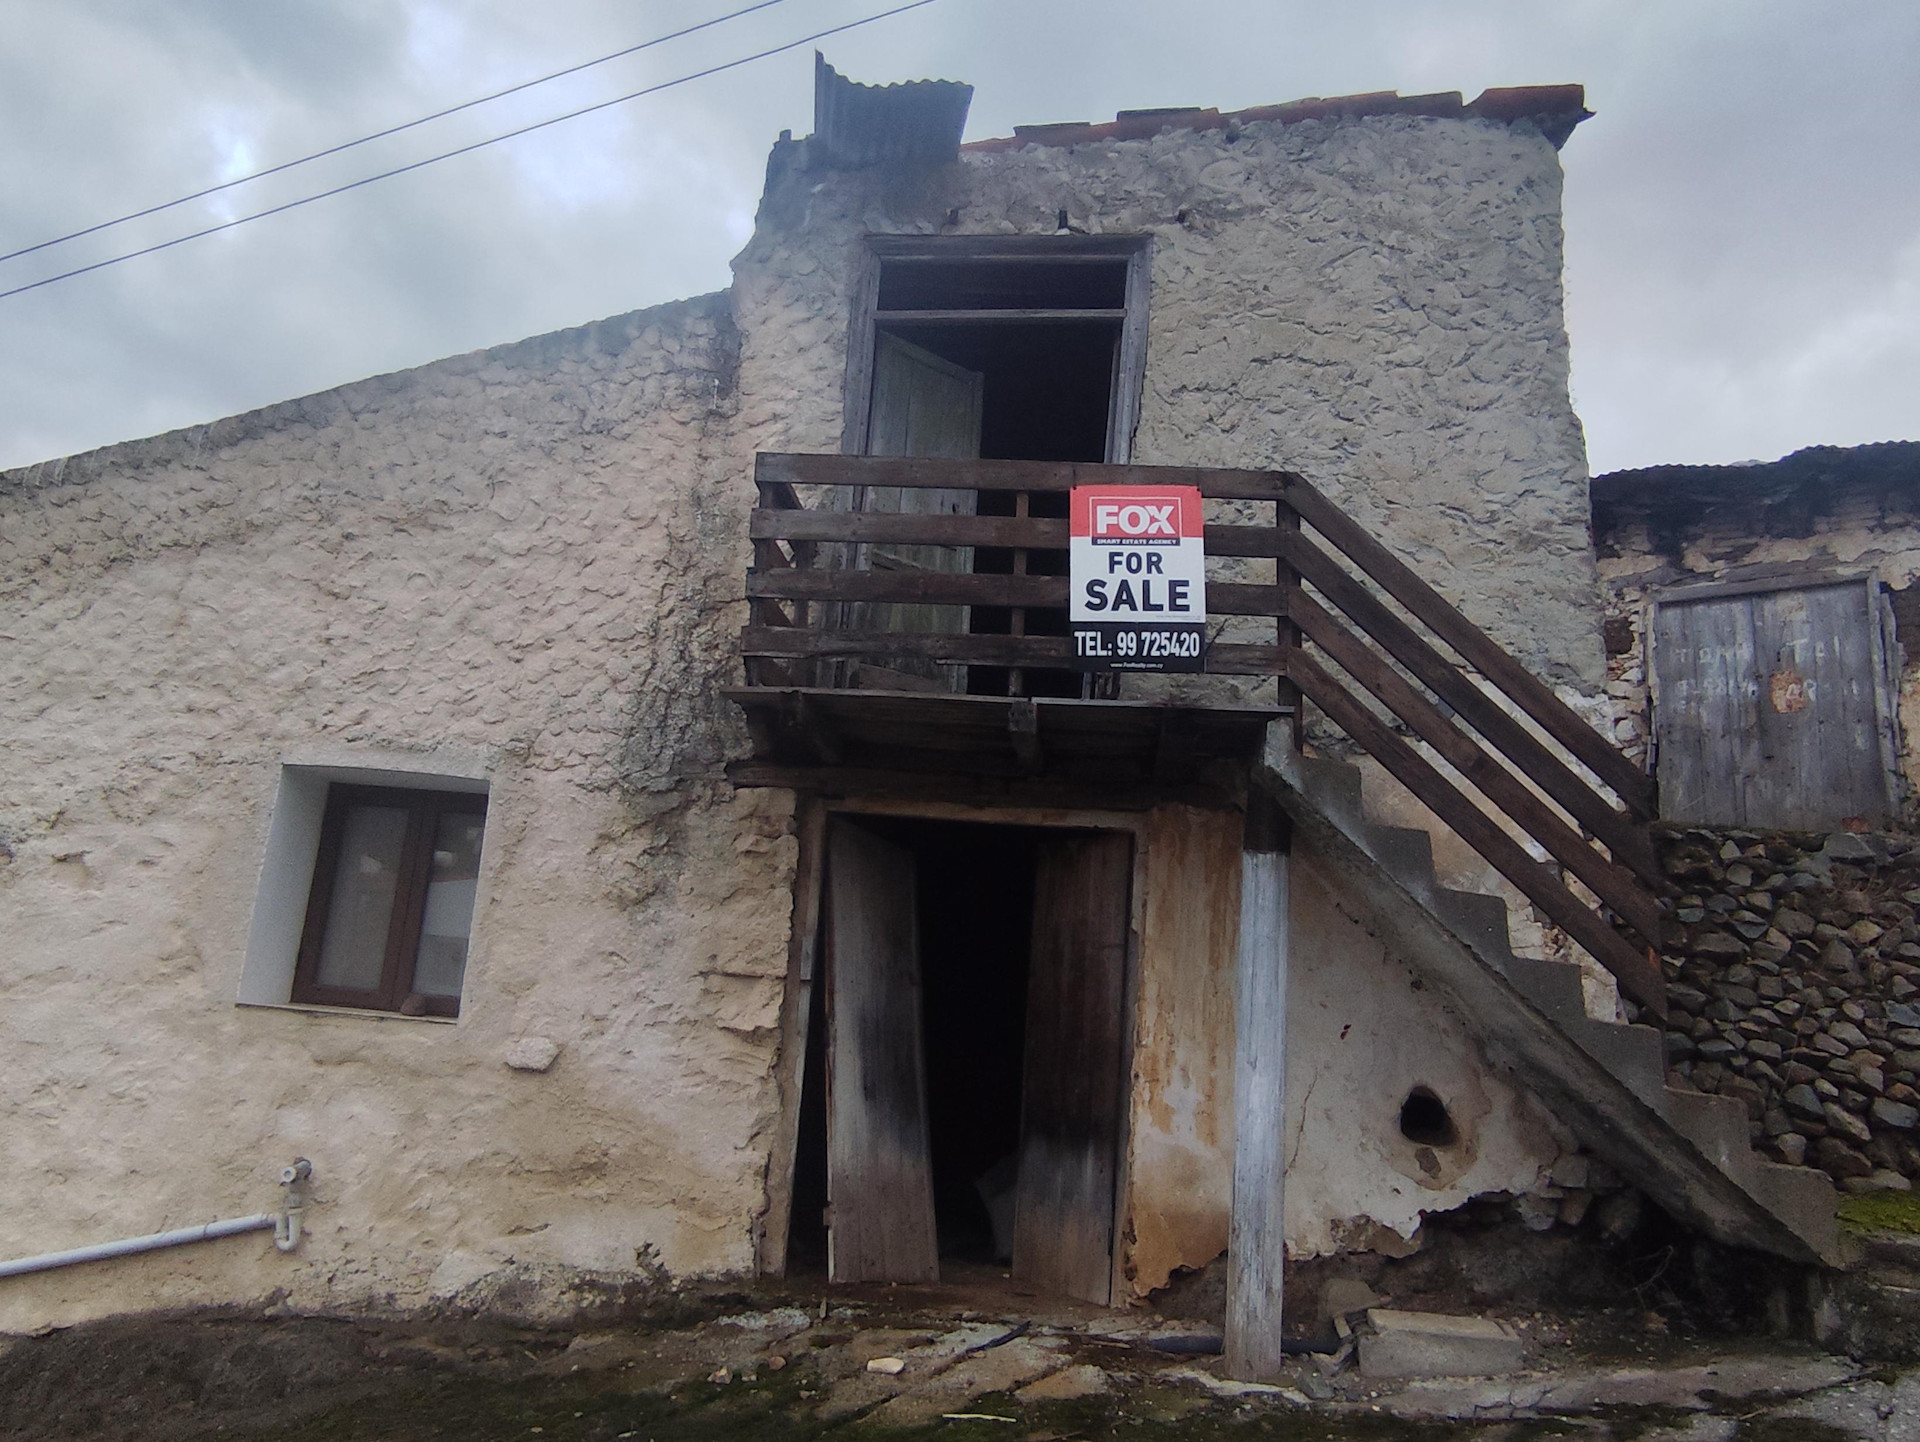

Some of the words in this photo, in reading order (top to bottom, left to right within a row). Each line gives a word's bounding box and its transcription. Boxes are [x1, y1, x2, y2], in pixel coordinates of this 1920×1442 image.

[1096, 505, 1176, 534] FOX
[1108, 552, 1164, 574] FOR
[1084, 579, 1190, 611] SALE
[1074, 631, 1112, 656] TEL:
[1116, 631, 1137, 656] 99
[1141, 631, 1200, 657] 725420
